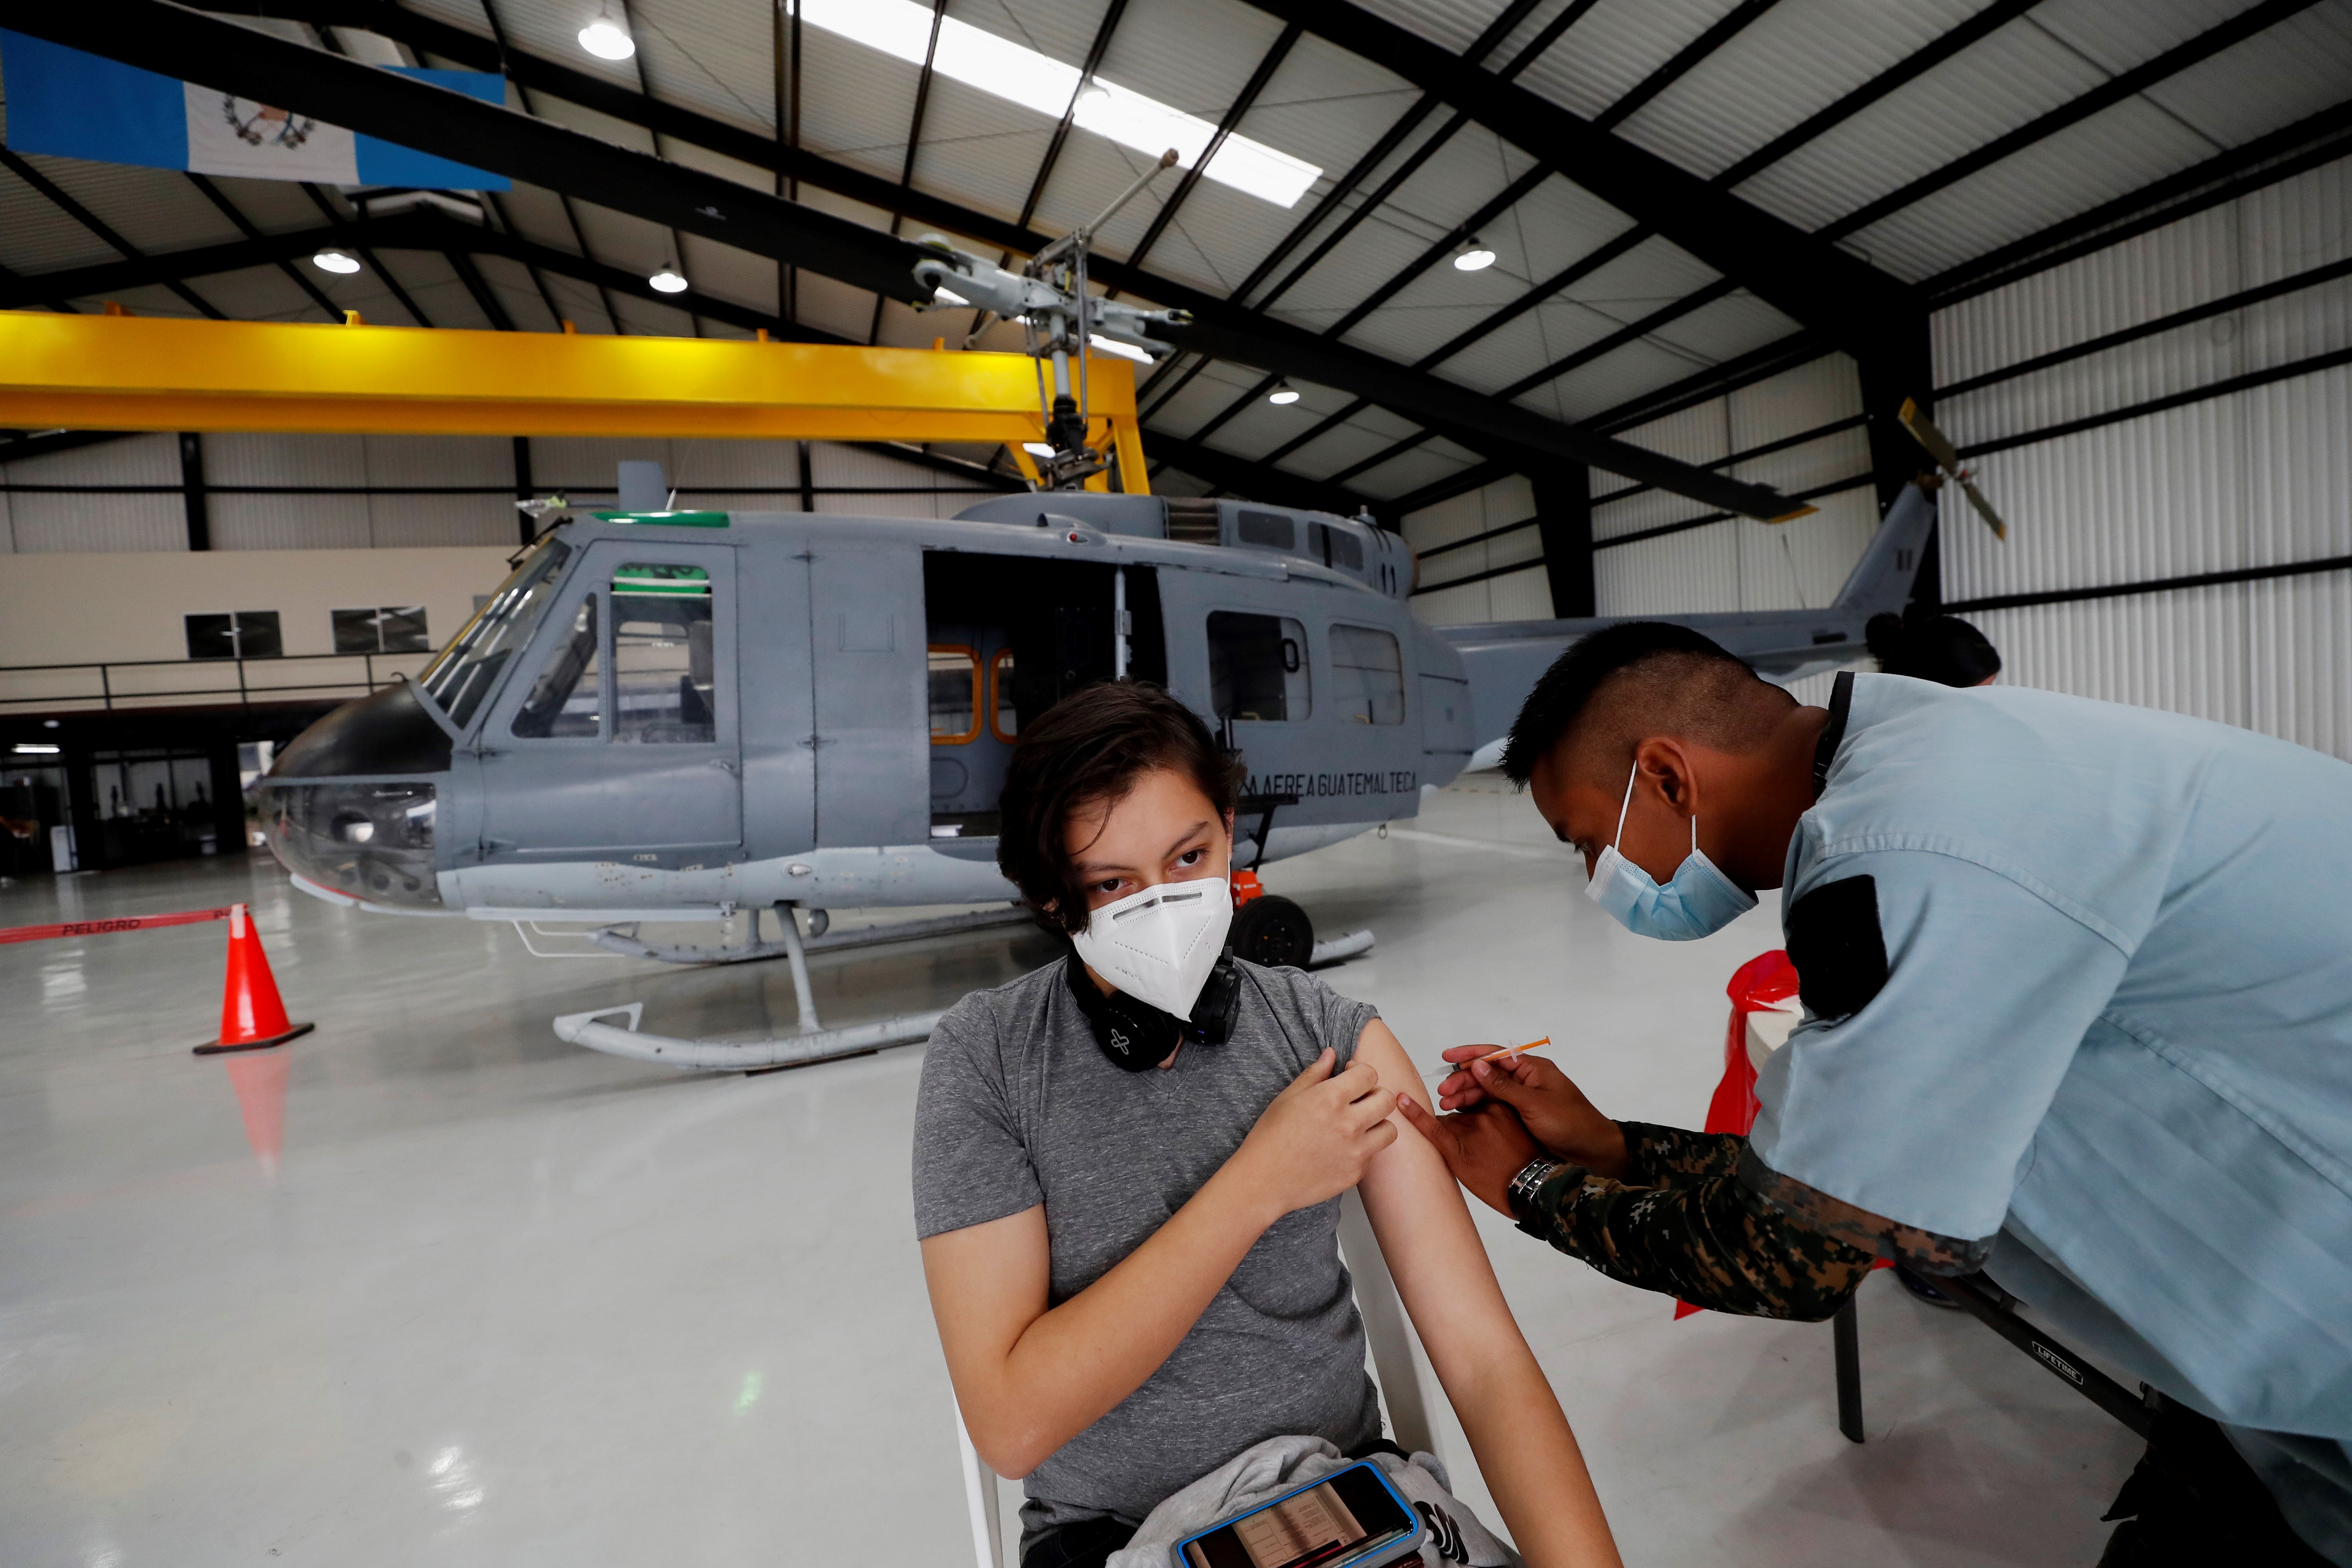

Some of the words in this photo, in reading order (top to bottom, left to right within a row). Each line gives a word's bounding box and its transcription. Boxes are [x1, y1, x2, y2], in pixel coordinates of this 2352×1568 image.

[1263, 774, 1314, 796] AEREA
[1318, 772, 1417, 796] GUATEMALTECA
[63, 919, 141, 936] PELIGRO
[2038, 1347, 2076, 1379] LIFETIME
